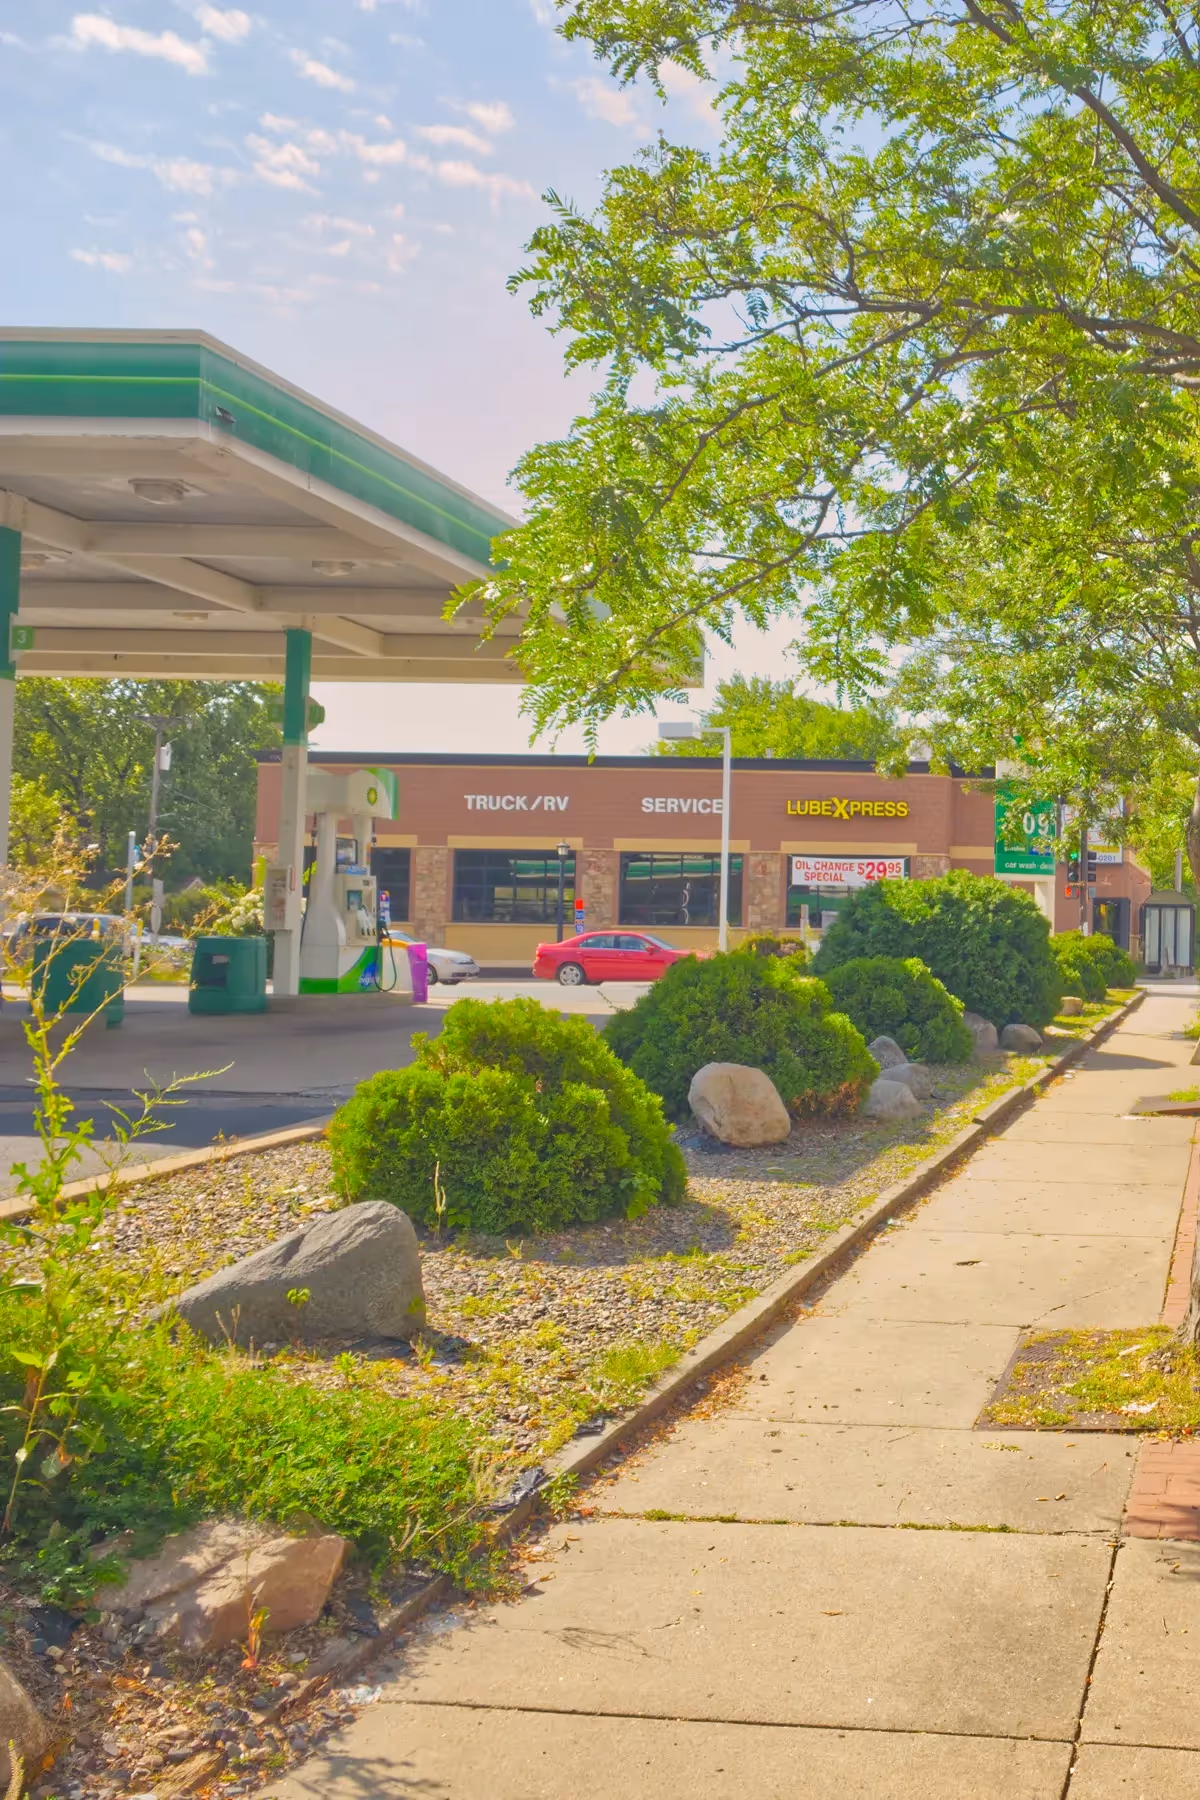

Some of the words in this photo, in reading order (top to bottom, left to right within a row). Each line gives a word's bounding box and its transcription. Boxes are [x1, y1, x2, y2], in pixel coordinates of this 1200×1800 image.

[463, 794, 570, 811] TRUCK/RV
[641, 797, 723, 814] SERVICE
[787, 797, 909, 820] LUBEXPRESS
[795, 860, 811, 870] OIL
[814, 861, 855, 872] CHANGE
[804, 871, 845, 882] SPECIAL
